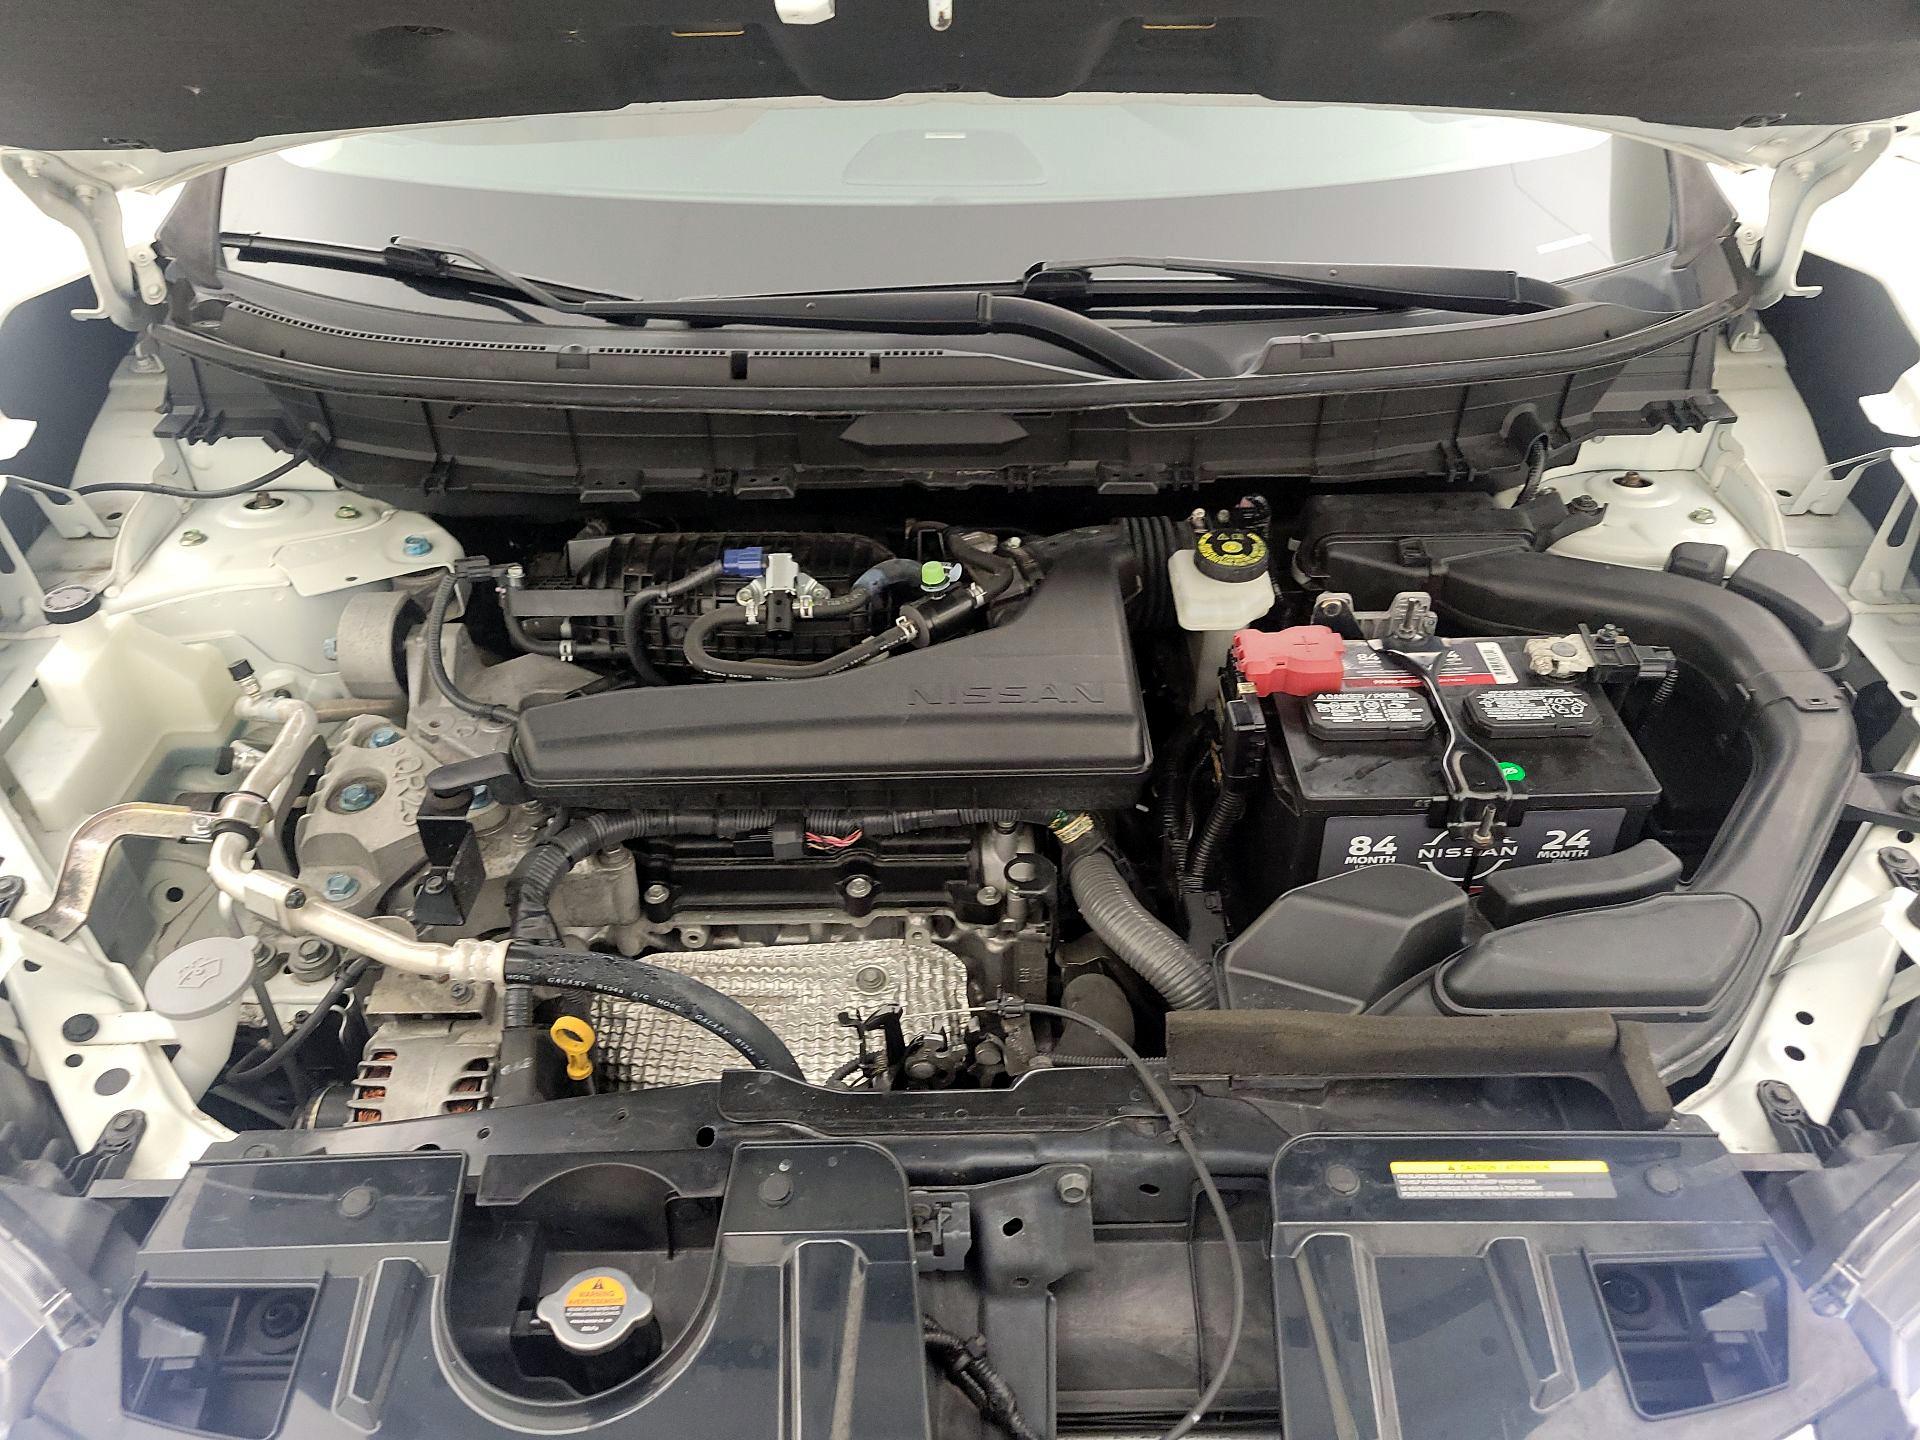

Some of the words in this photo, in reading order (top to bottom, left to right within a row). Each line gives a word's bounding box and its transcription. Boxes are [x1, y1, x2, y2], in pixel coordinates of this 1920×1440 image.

[906, 684, 1105, 705] NISSAN
[1348, 835, 1398, 855] 84
[1541, 829, 1591, 849] 24
[1344, 855, 1397, 864] MONTH
[1417, 846, 1519, 859] NISSAN
[1536, 850, 1590, 859] MONTH
[547, 977, 588, 987] GALAXY
[694, 1014, 732, 1036] GALAXY
